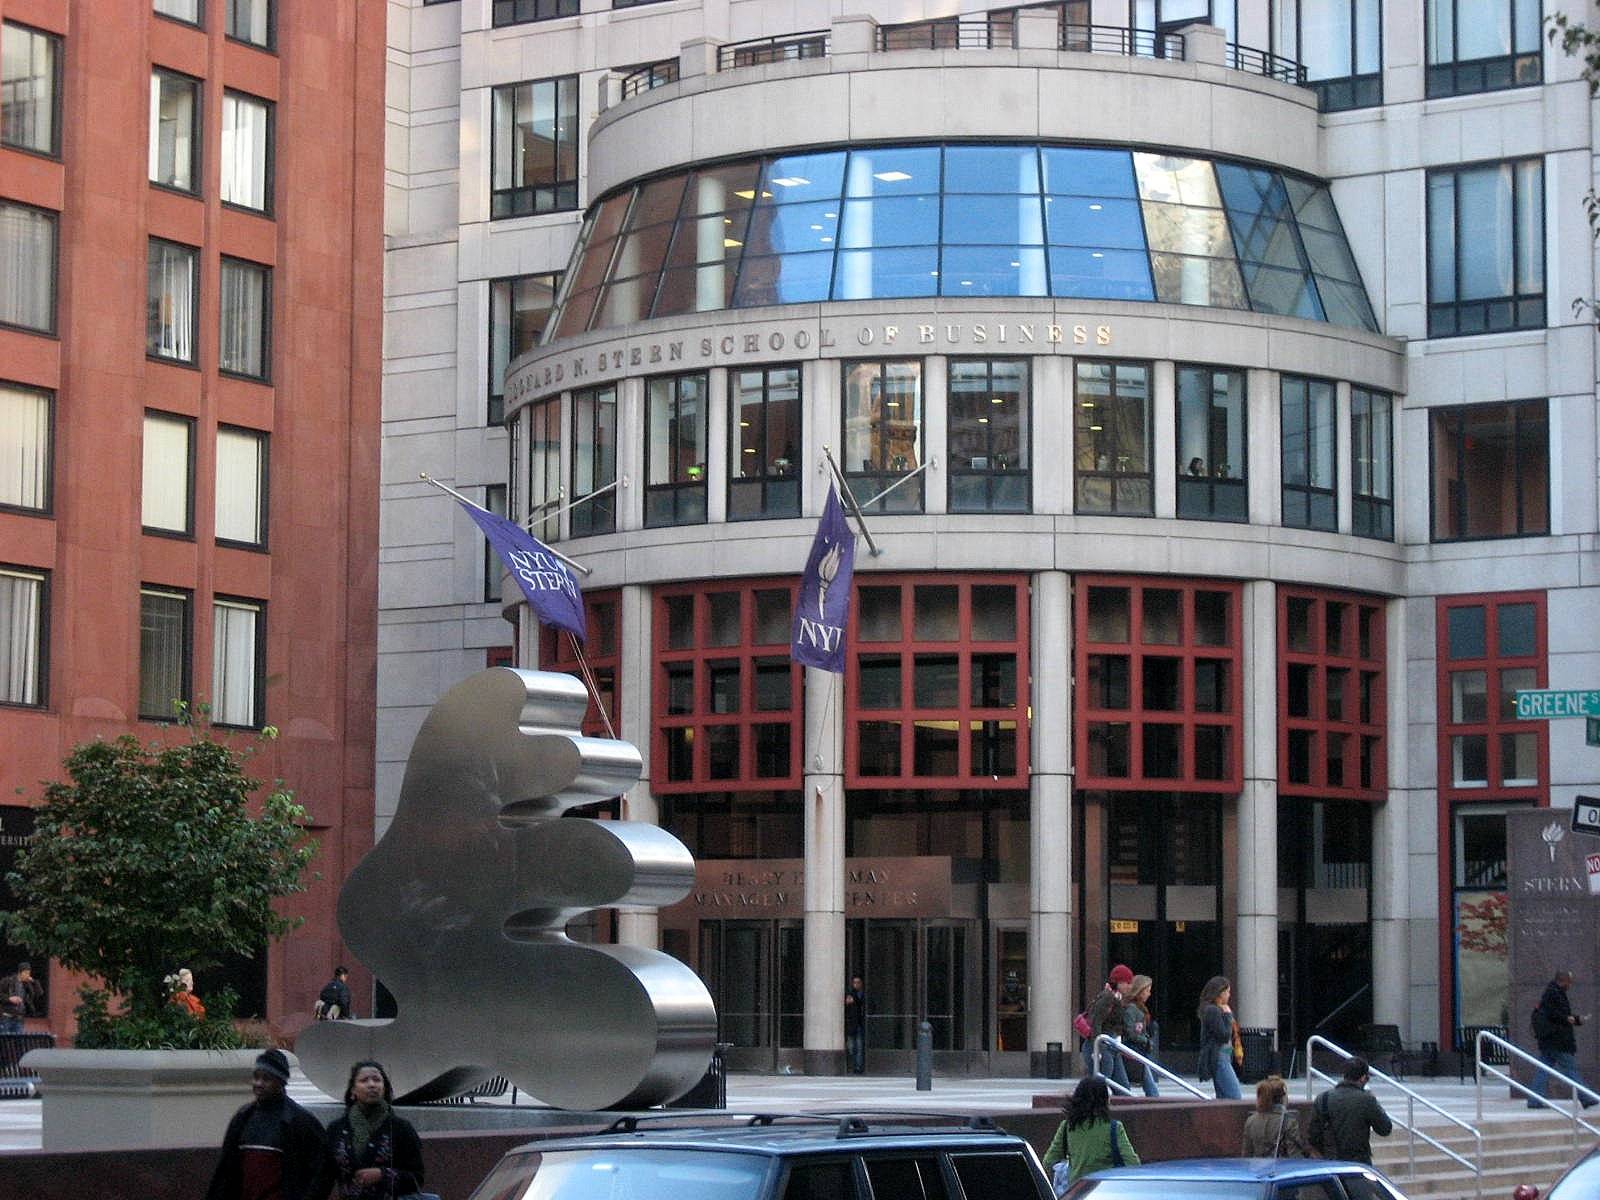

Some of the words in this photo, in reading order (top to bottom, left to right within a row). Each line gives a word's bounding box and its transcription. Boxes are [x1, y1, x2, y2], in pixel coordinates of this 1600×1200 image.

[573, 357, 588, 378] N.
[598, 341, 684, 372] STERN
[700, 329, 836, 357] SCHOOL
[857, 325, 899, 346] OF
[919, 323, 1112, 346] BUSINESS
[508, 550, 558, 571] NYU
[1519, 692, 1589, 716] GREENE
[1524, 876, 1586, 892] STERN
